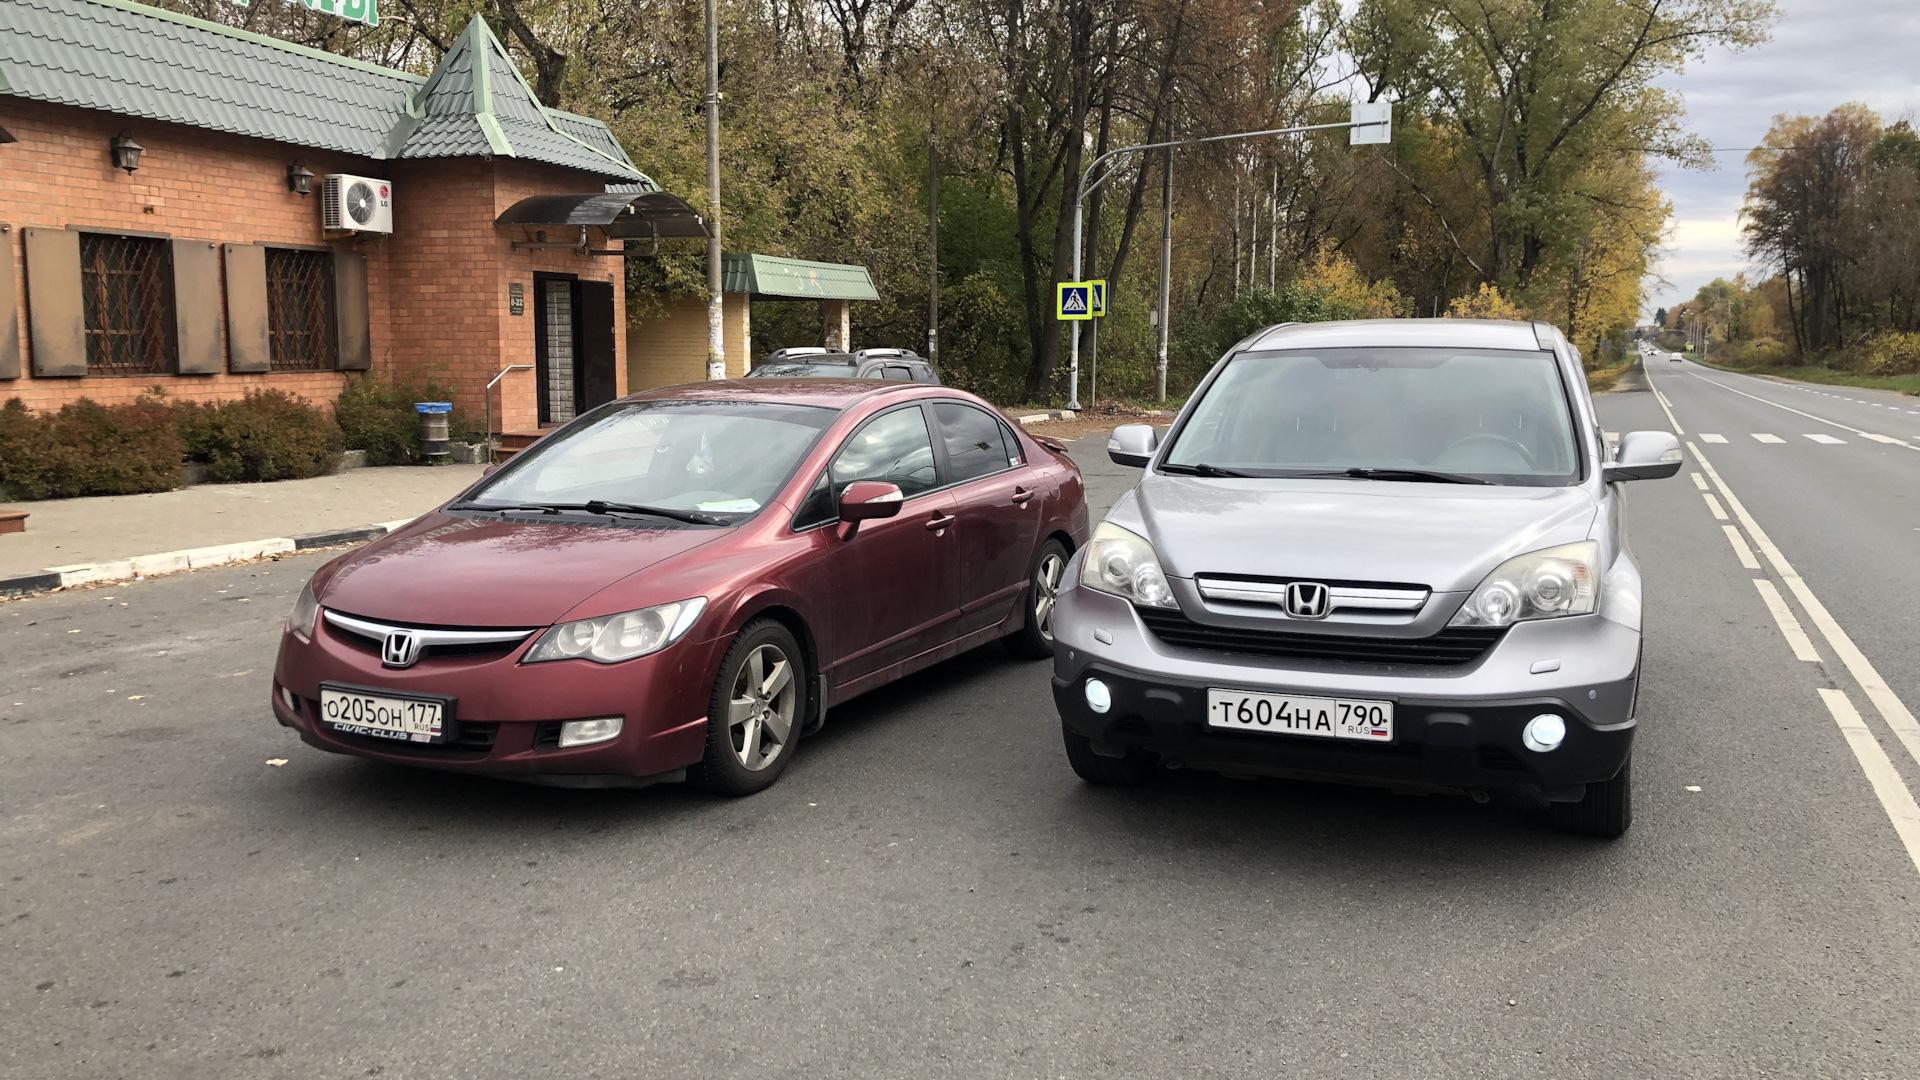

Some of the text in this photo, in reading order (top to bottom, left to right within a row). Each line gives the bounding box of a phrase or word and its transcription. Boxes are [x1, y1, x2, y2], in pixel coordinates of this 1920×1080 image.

[327, 696, 437, 727] О205ОН 177
[1219, 698, 1383, 731] Т604НА 790
[413, 723, 430, 731] RUS
[1347, 725, 1370, 735] RUS
